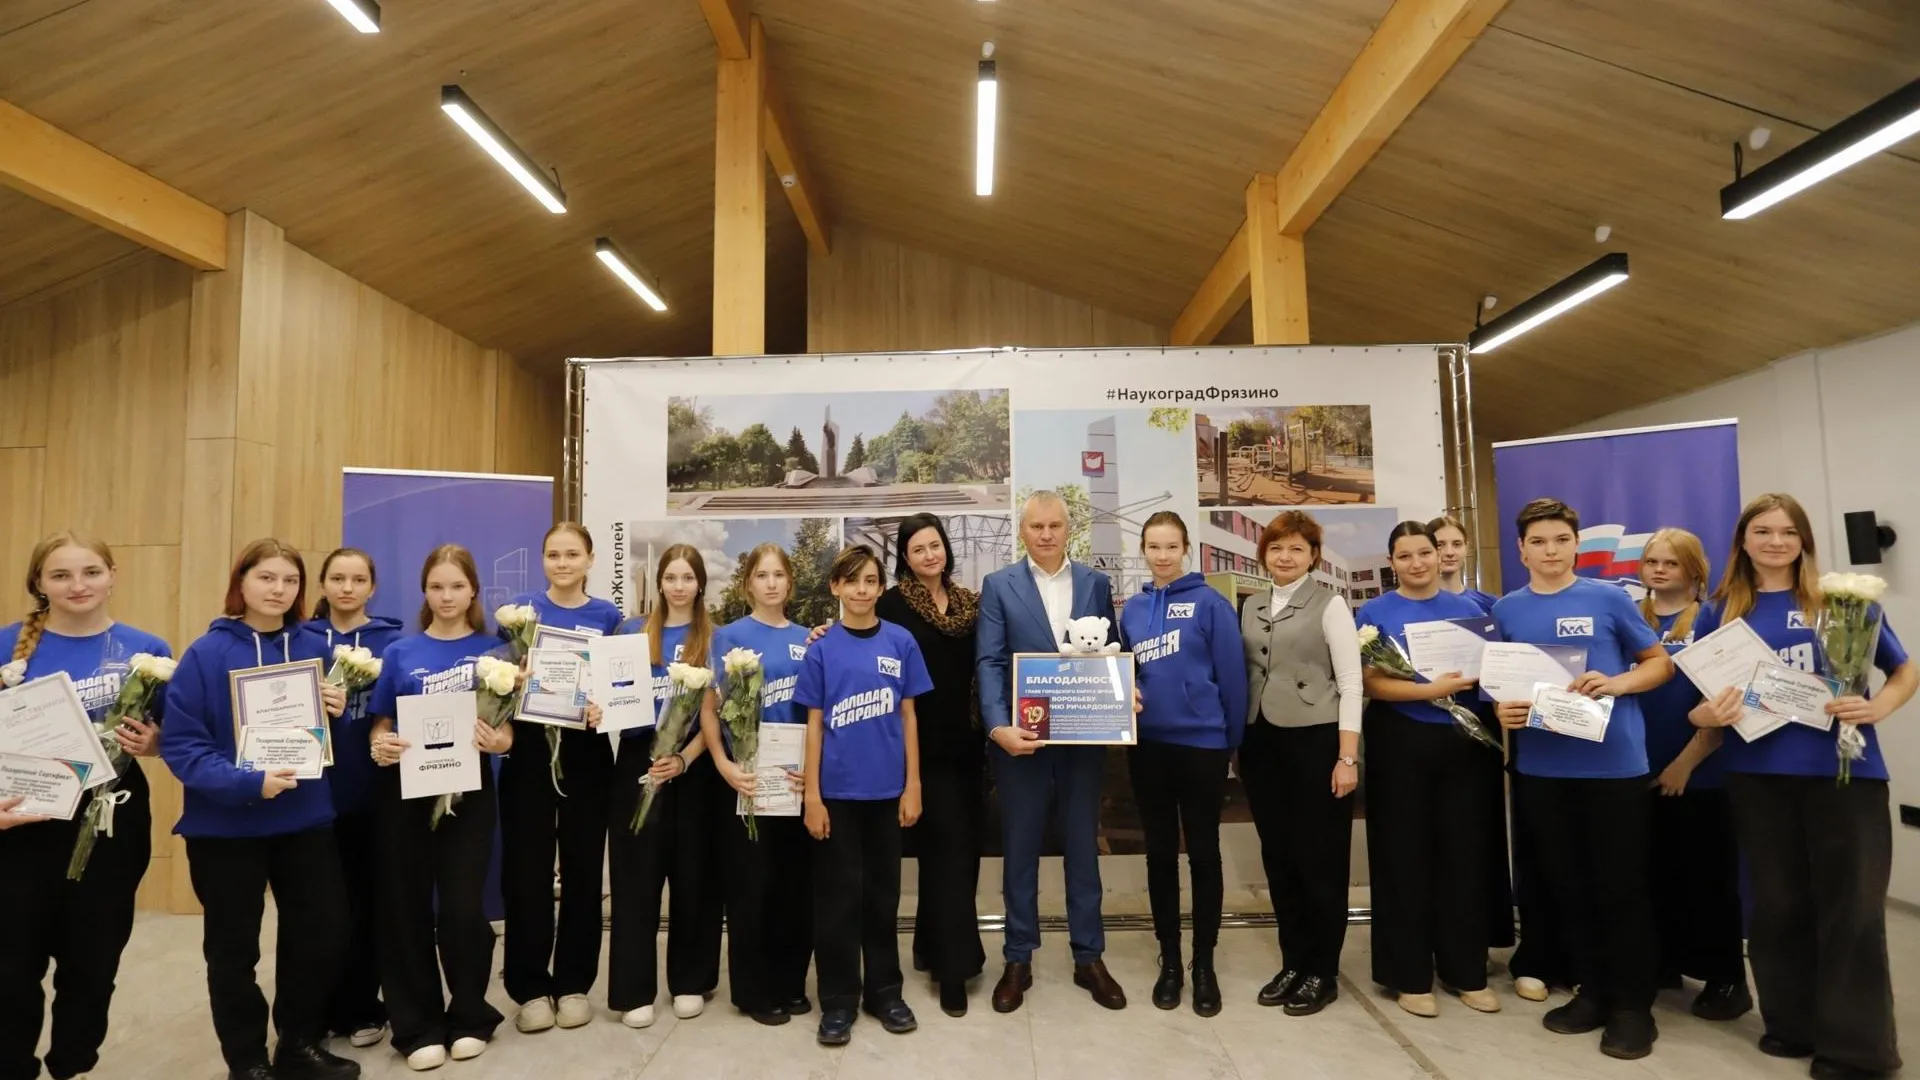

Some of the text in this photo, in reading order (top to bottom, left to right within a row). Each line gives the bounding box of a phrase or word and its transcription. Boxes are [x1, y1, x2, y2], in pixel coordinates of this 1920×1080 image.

[1106, 386, 1280, 403] #НаукоградФрязино
[1026, 675, 1118, 685] БЛАГОДАРНОСТ
[832, 687, 895, 717] МОЛОДАЯ
[830, 700, 895, 730] ГВАРДИЯ
[1023, 706, 1045, 724] 19
[418, 761, 462, 771] ФРЯЗИНО
